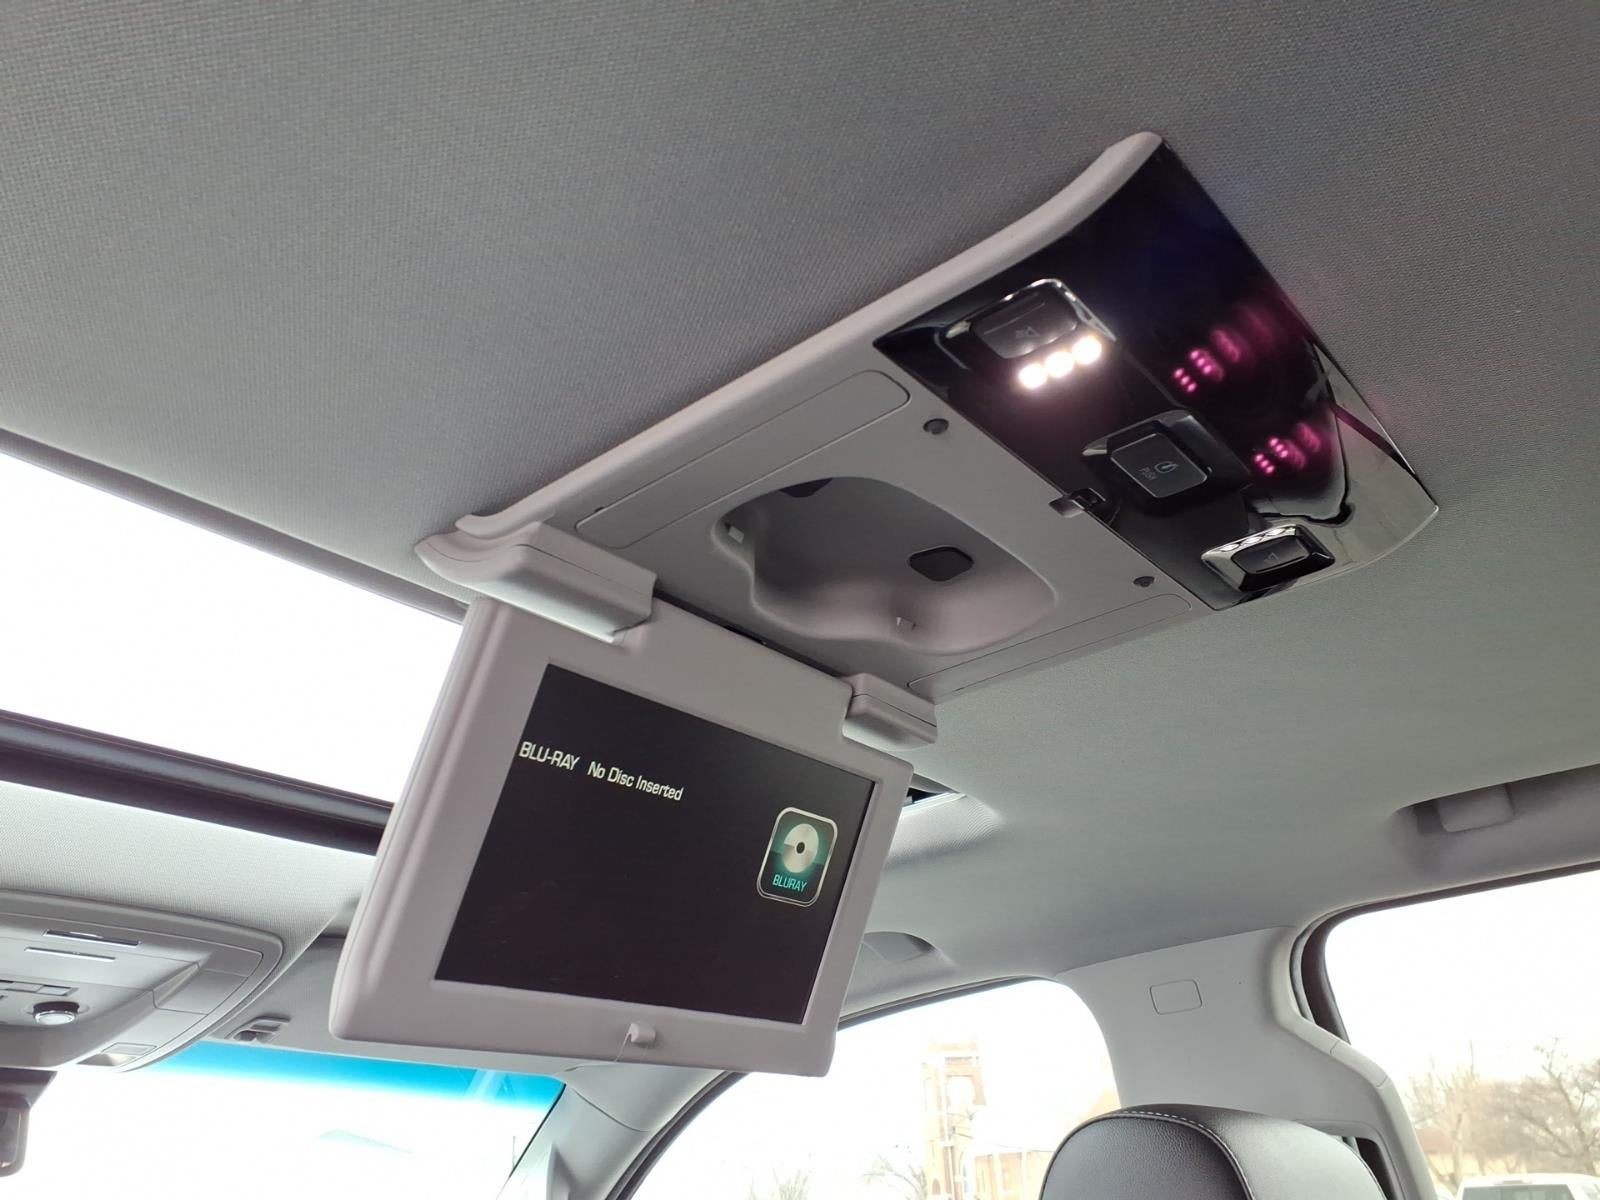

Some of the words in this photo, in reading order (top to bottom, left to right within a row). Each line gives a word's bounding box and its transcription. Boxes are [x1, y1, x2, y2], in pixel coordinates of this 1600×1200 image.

[518, 741, 580, 770] BLU-RAY
[587, 761, 606, 779] No
[607, 767, 634, 788] Disc
[635, 775, 684, 801] Inserted
[772, 874, 807, 892] BLURAY
